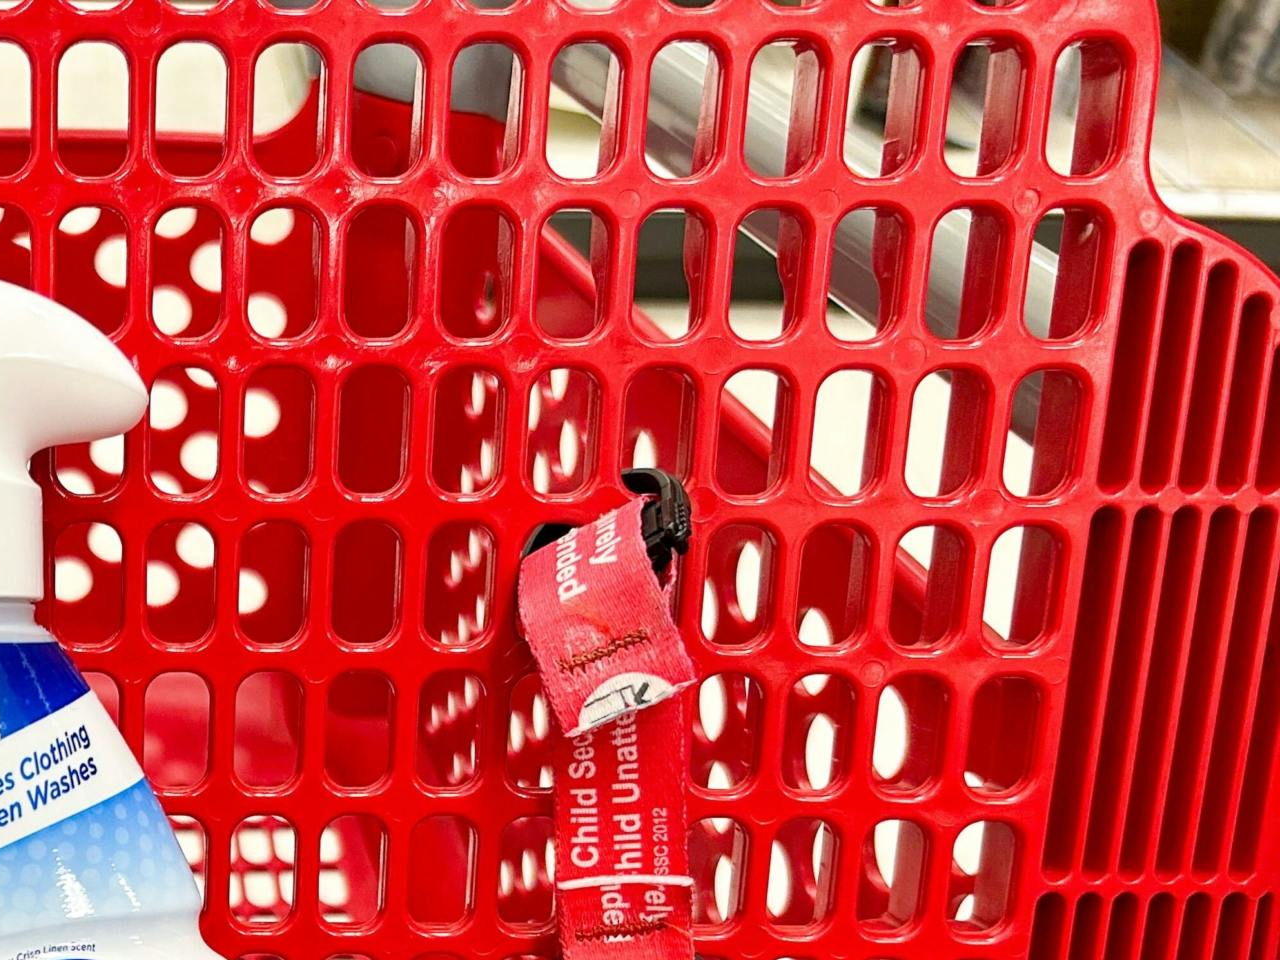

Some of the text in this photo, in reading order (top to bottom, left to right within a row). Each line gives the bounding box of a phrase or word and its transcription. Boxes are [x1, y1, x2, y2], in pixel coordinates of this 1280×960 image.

[20, 724, 92, 780] Clothing
[27, 757, 98, 811] Washes
[570, 787, 600, 869] Child
[612, 813, 642, 874] hild
[653, 807, 668, 842] 2012
[43, 944, 69, 954] Linen
